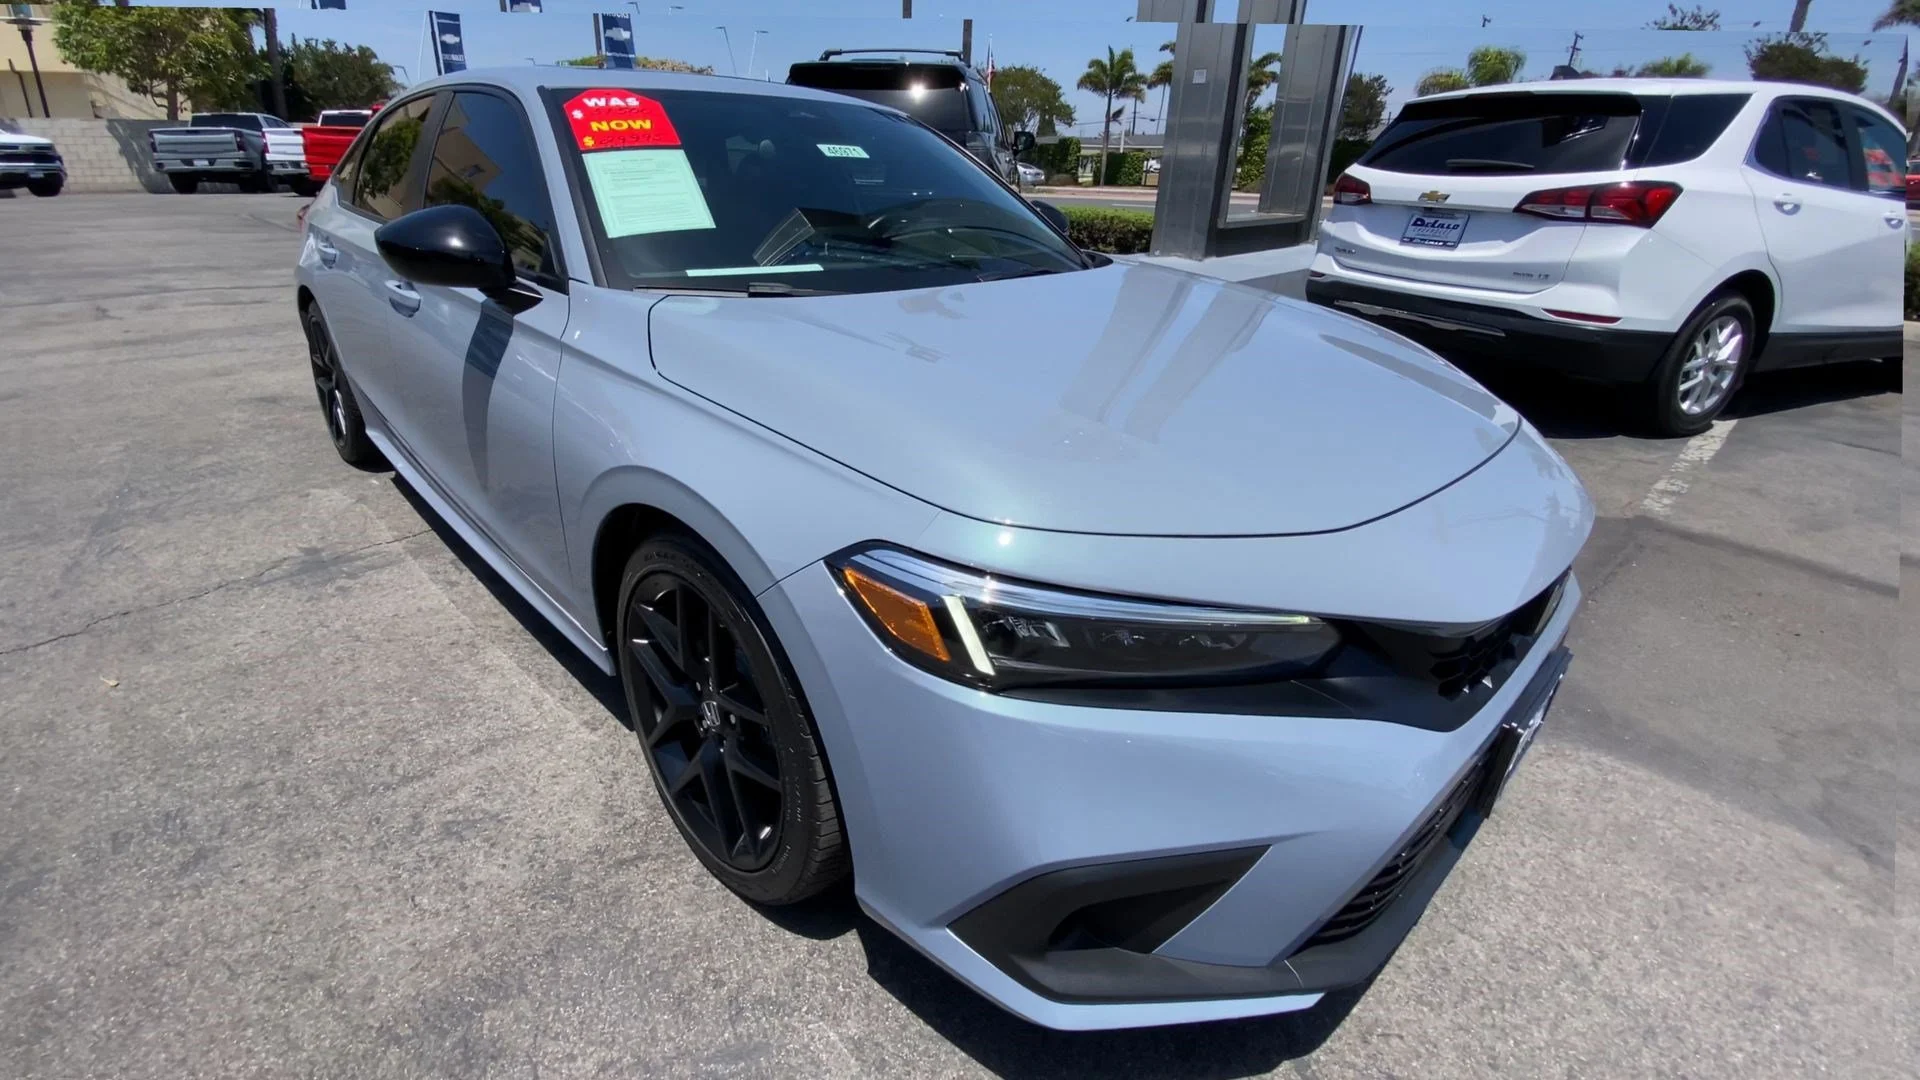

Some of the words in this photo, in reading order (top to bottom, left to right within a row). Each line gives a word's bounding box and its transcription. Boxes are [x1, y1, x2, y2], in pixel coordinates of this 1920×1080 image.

[582, 97, 640, 107] WAS
[571, 109, 584, 120] $
[590, 119, 653, 132] NOW
[583, 135, 595, 147] $
